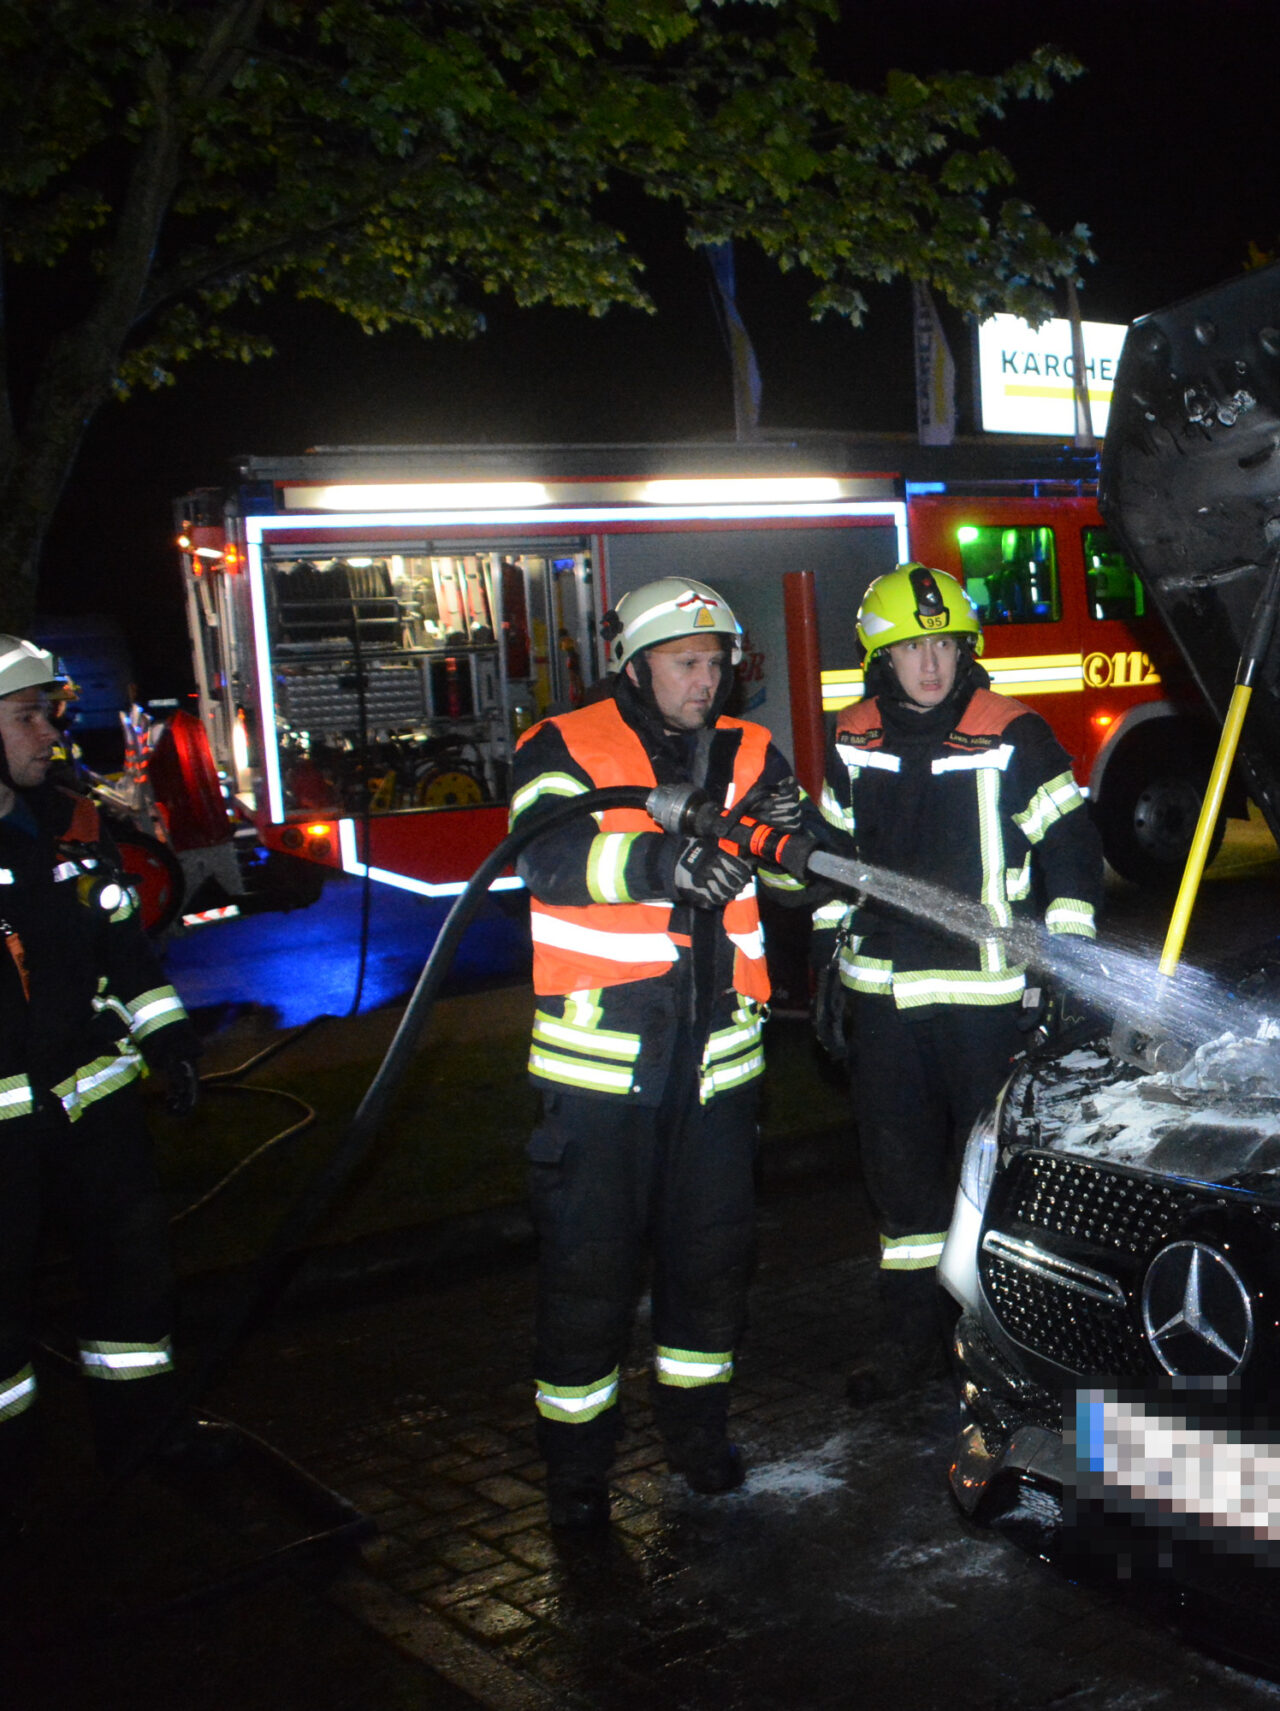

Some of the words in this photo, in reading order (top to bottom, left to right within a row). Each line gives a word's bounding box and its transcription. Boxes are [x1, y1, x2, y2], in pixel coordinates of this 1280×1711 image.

[1001, 350, 1118, 381] KÄRCHE
[927, 617, 942, 628] 95
[1109, 651, 1161, 688] 112
